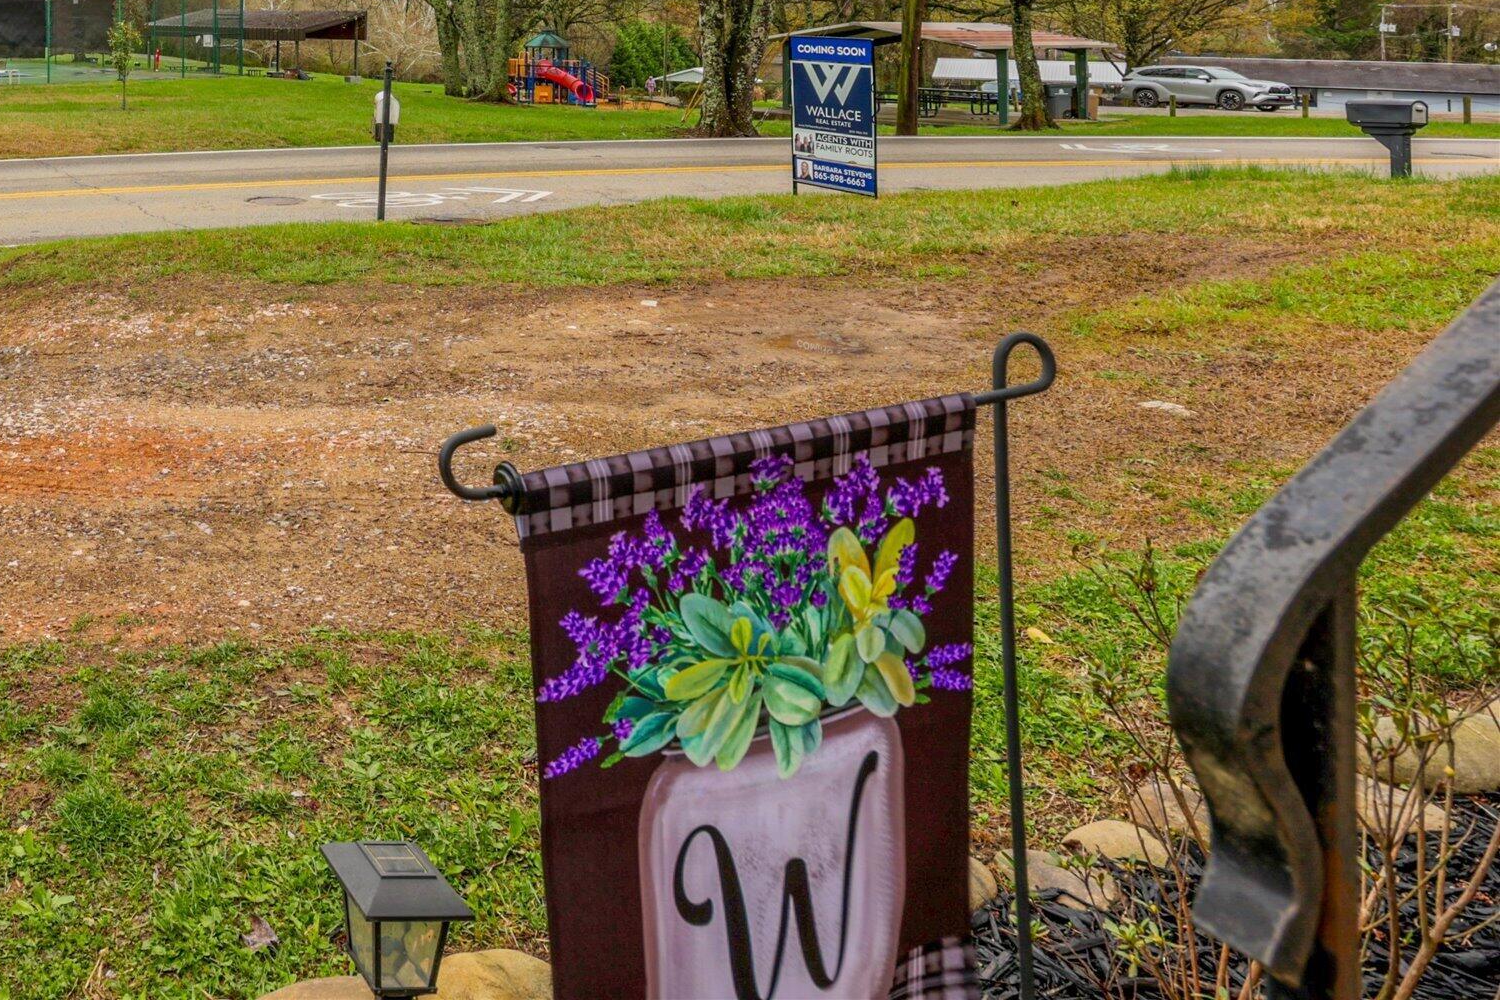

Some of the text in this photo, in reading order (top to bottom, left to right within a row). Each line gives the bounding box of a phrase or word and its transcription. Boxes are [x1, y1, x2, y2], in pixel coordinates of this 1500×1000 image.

[797, 44, 866, 56] COMING SOON
[805, 105, 862, 122] WALLACE
[831, 120, 852, 128] ESTATE
[816, 134, 872, 148] AGENTS WITH
[816, 143, 873, 157] FAMILY ROOTS
[813, 164, 873, 179] BARBARA STEVENS
[813, 171, 866, 187] 865-898-6663
[673, 750, 879, 1000] W
